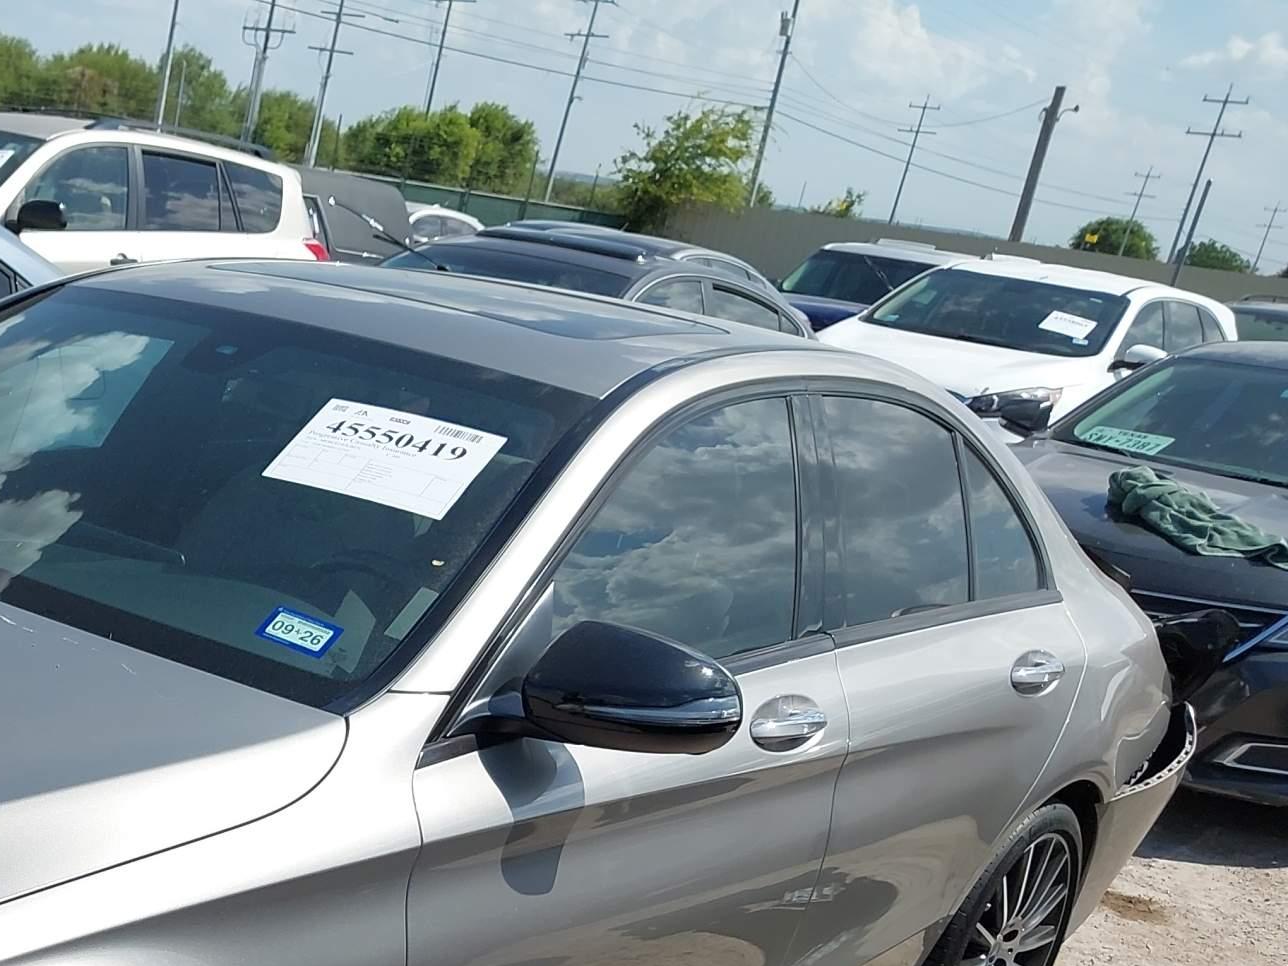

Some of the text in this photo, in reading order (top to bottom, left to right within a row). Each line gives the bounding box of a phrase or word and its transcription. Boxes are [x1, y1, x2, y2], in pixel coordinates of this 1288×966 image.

[326, 420, 468, 461] 45550419
[271, 620, 324, 646] 09 26
